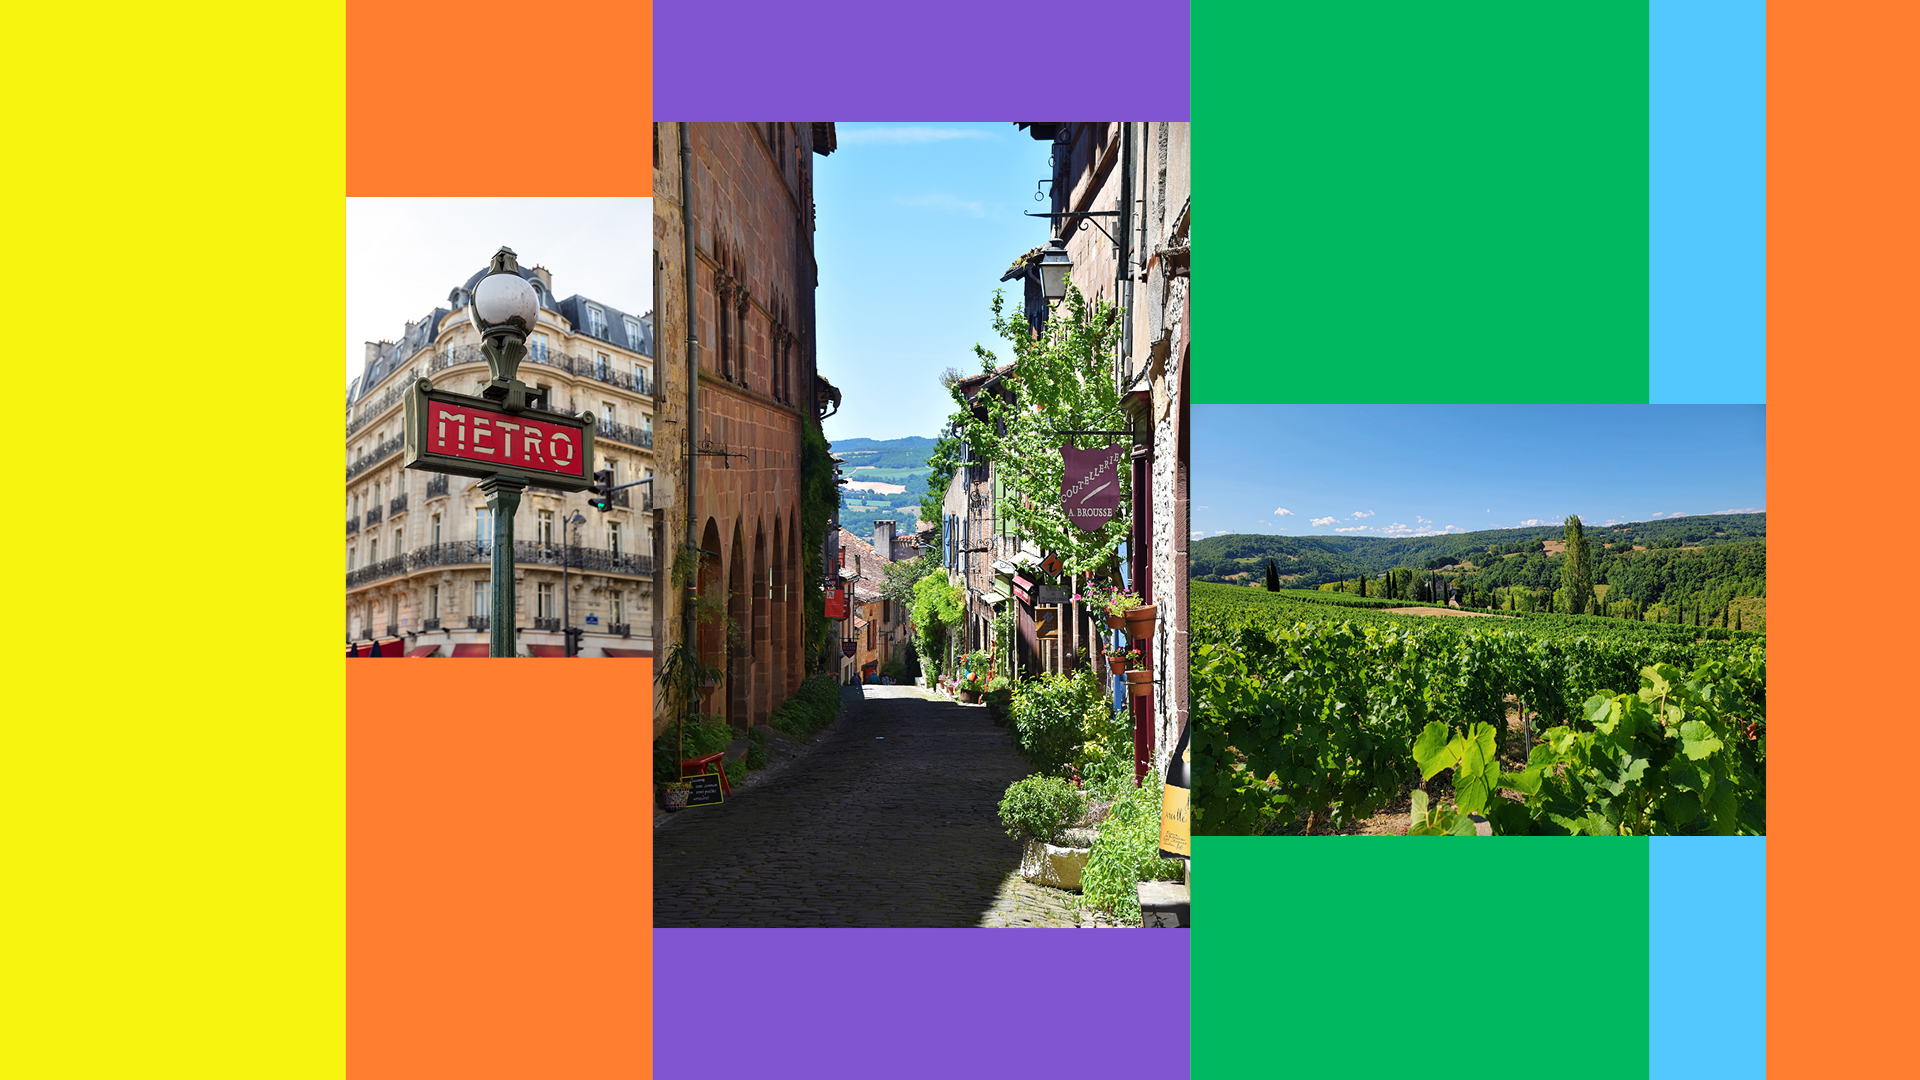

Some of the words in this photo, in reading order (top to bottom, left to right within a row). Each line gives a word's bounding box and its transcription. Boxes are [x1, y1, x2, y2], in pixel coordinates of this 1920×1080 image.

[438, 410, 573, 466] METRO
[1060, 453, 1119, 503] COUTELLERIE
[1068, 508, 1076, 517] A.
[1077, 508, 1112, 517] BROUSSE
